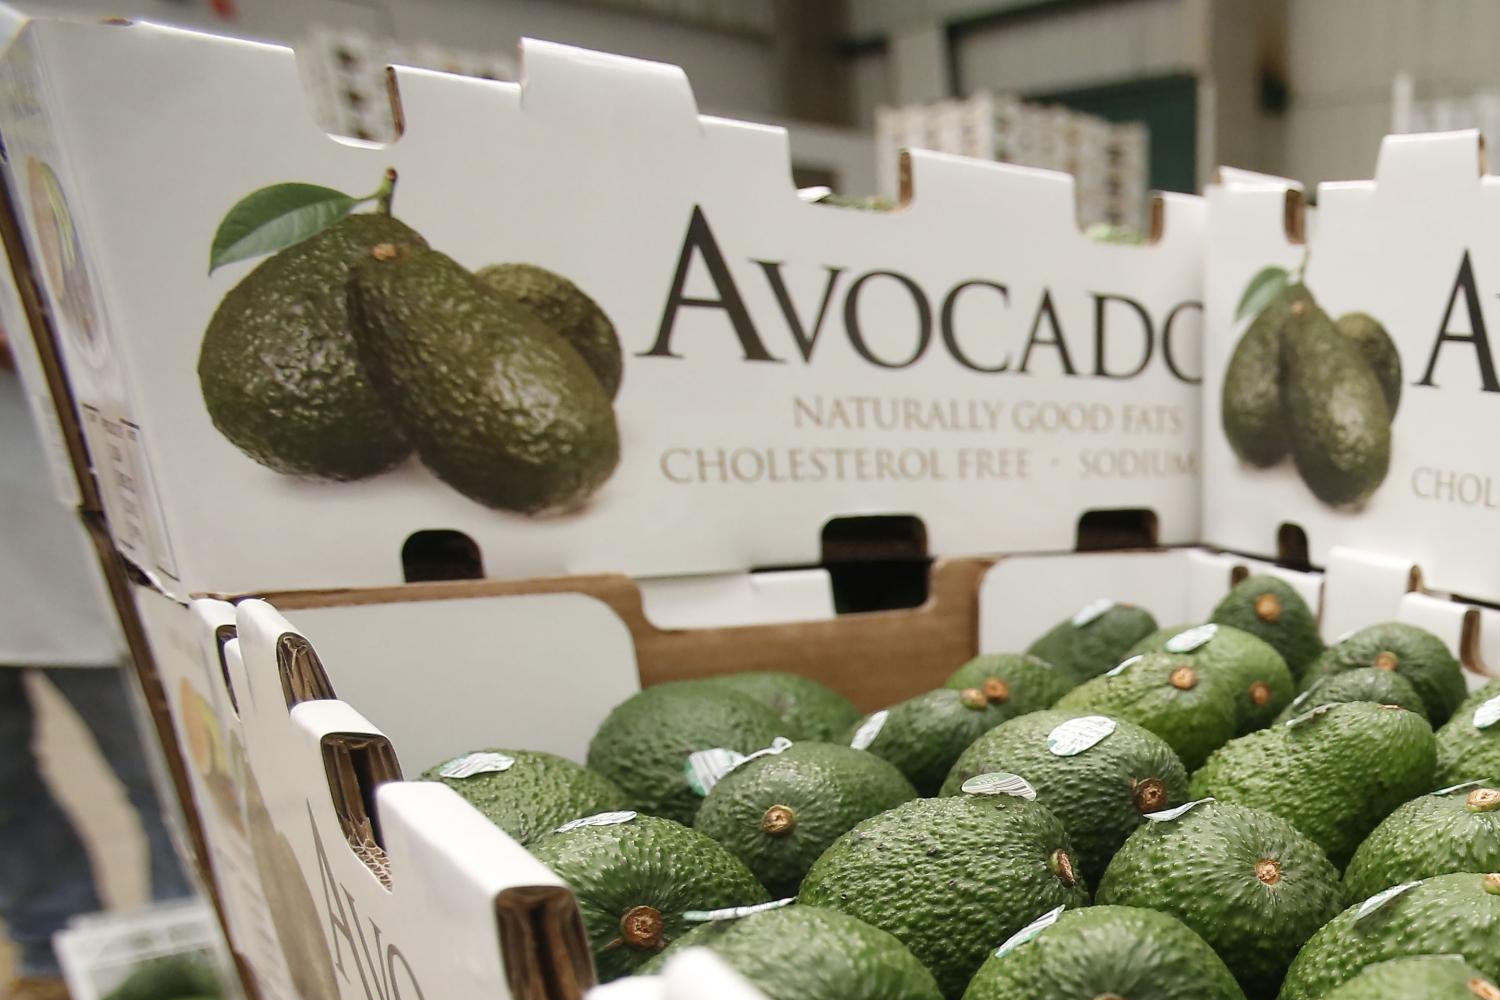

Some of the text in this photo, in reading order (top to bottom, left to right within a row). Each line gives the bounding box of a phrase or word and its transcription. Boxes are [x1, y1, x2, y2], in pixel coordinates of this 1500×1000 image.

[792, 396, 1184, 436] NATURALLY GOOD FATS
[659, 447, 943, 484] CHOLESTEROL
[956, 448, 1031, 480] FREE
